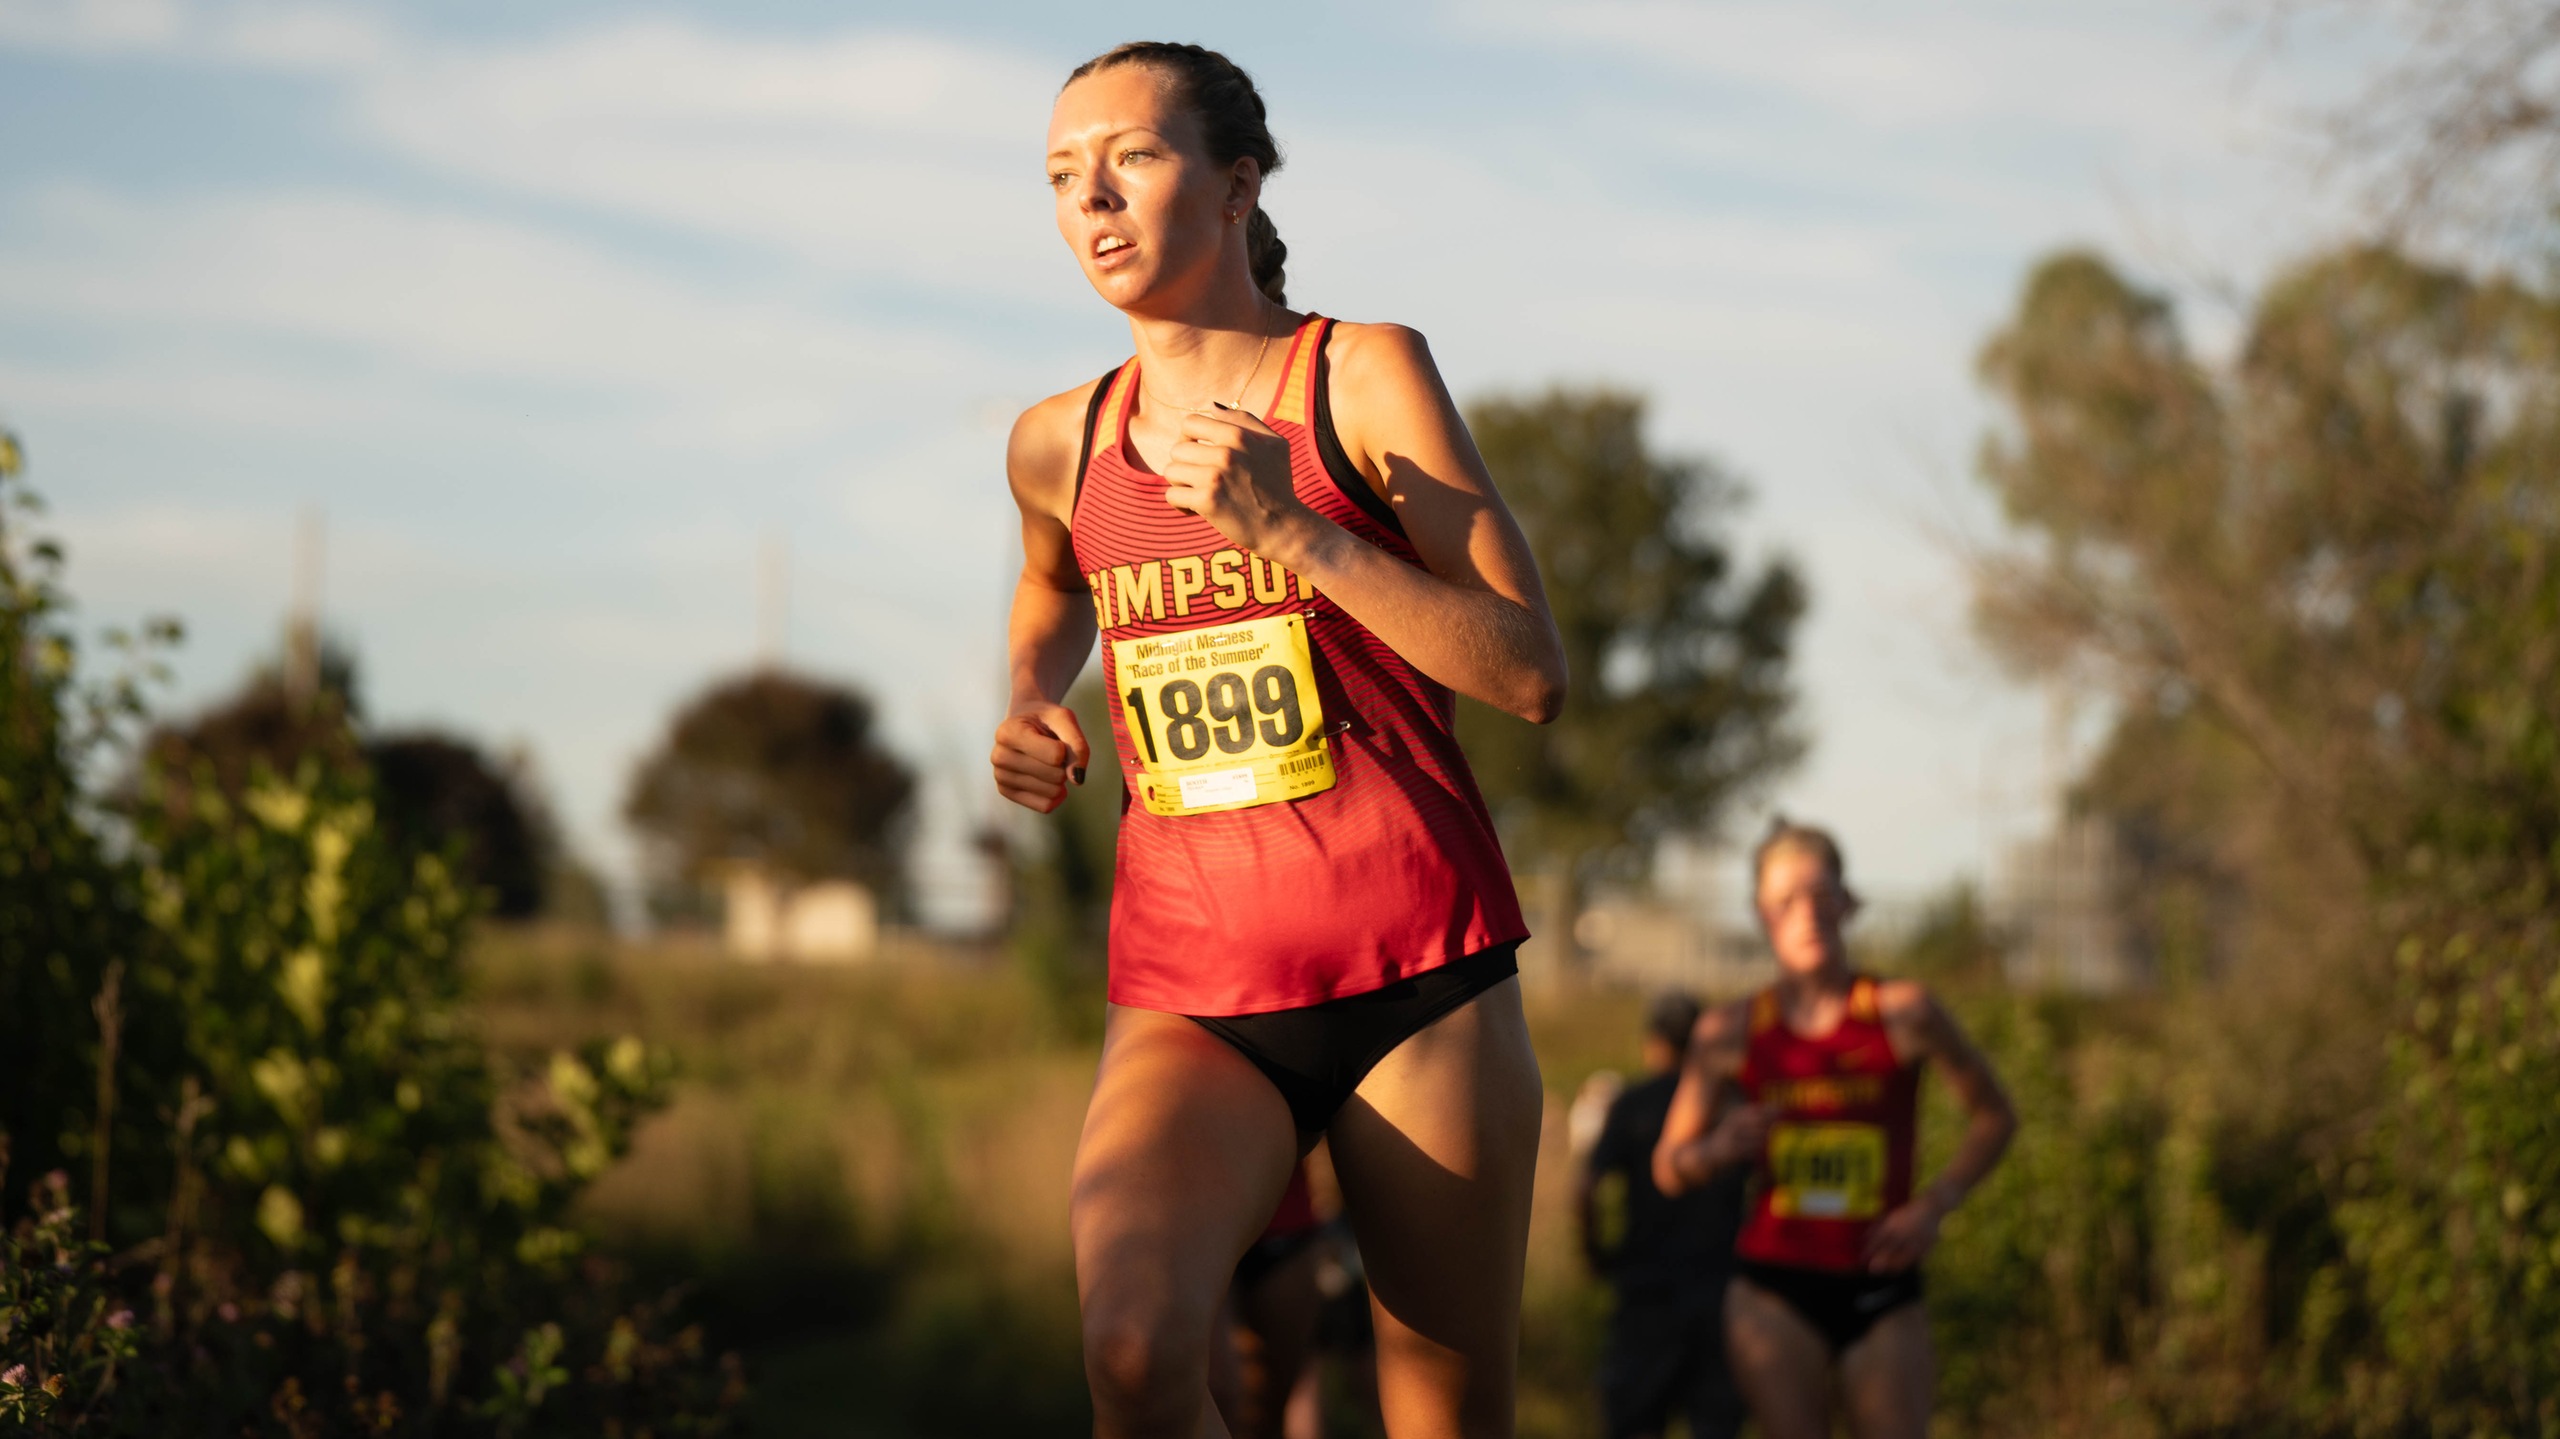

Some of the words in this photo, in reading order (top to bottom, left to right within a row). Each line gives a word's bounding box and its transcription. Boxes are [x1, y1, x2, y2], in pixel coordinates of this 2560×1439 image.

[1126, 662, 1164, 679] "Race
[1168, 658, 1180, 674] of
[1185, 654, 1207, 671] the
[1210, 643, 1270, 667] Summer"
[1136, 638, 1192, 660] Midnight
[1196, 629, 1254, 650] Madness
[1126, 664, 1304, 763] 1899
